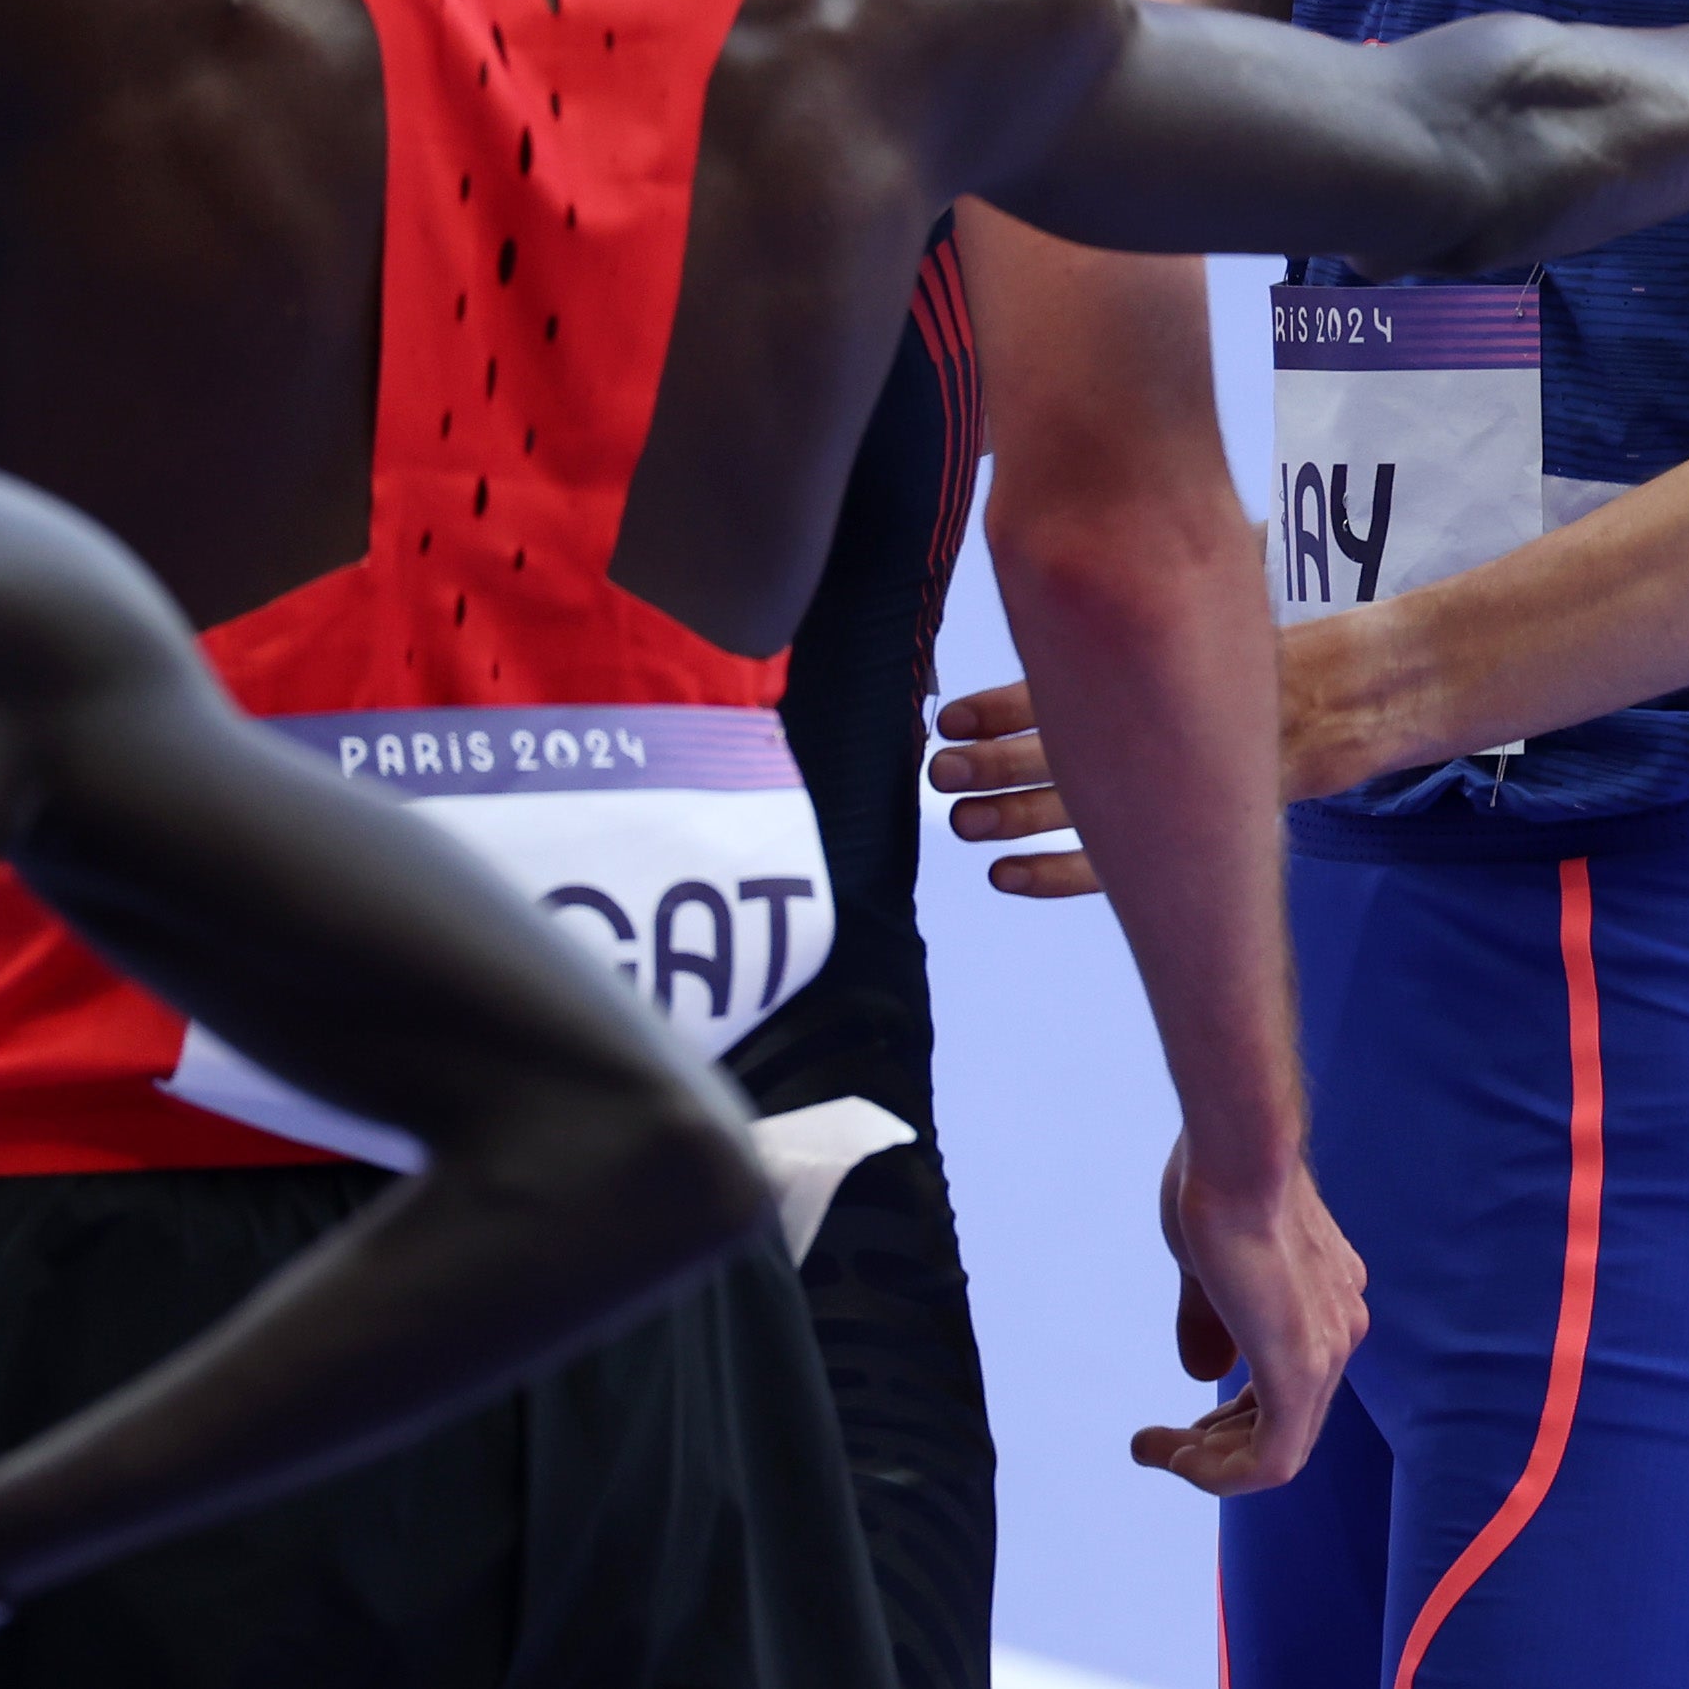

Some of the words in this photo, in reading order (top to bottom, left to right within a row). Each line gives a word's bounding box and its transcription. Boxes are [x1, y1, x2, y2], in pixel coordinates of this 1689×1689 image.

[1315, 306, 1393, 343] 2024
[1281, 461, 1396, 602] AY
[338, 729, 495, 778] PARIS
[509, 727, 647, 772] 2024
